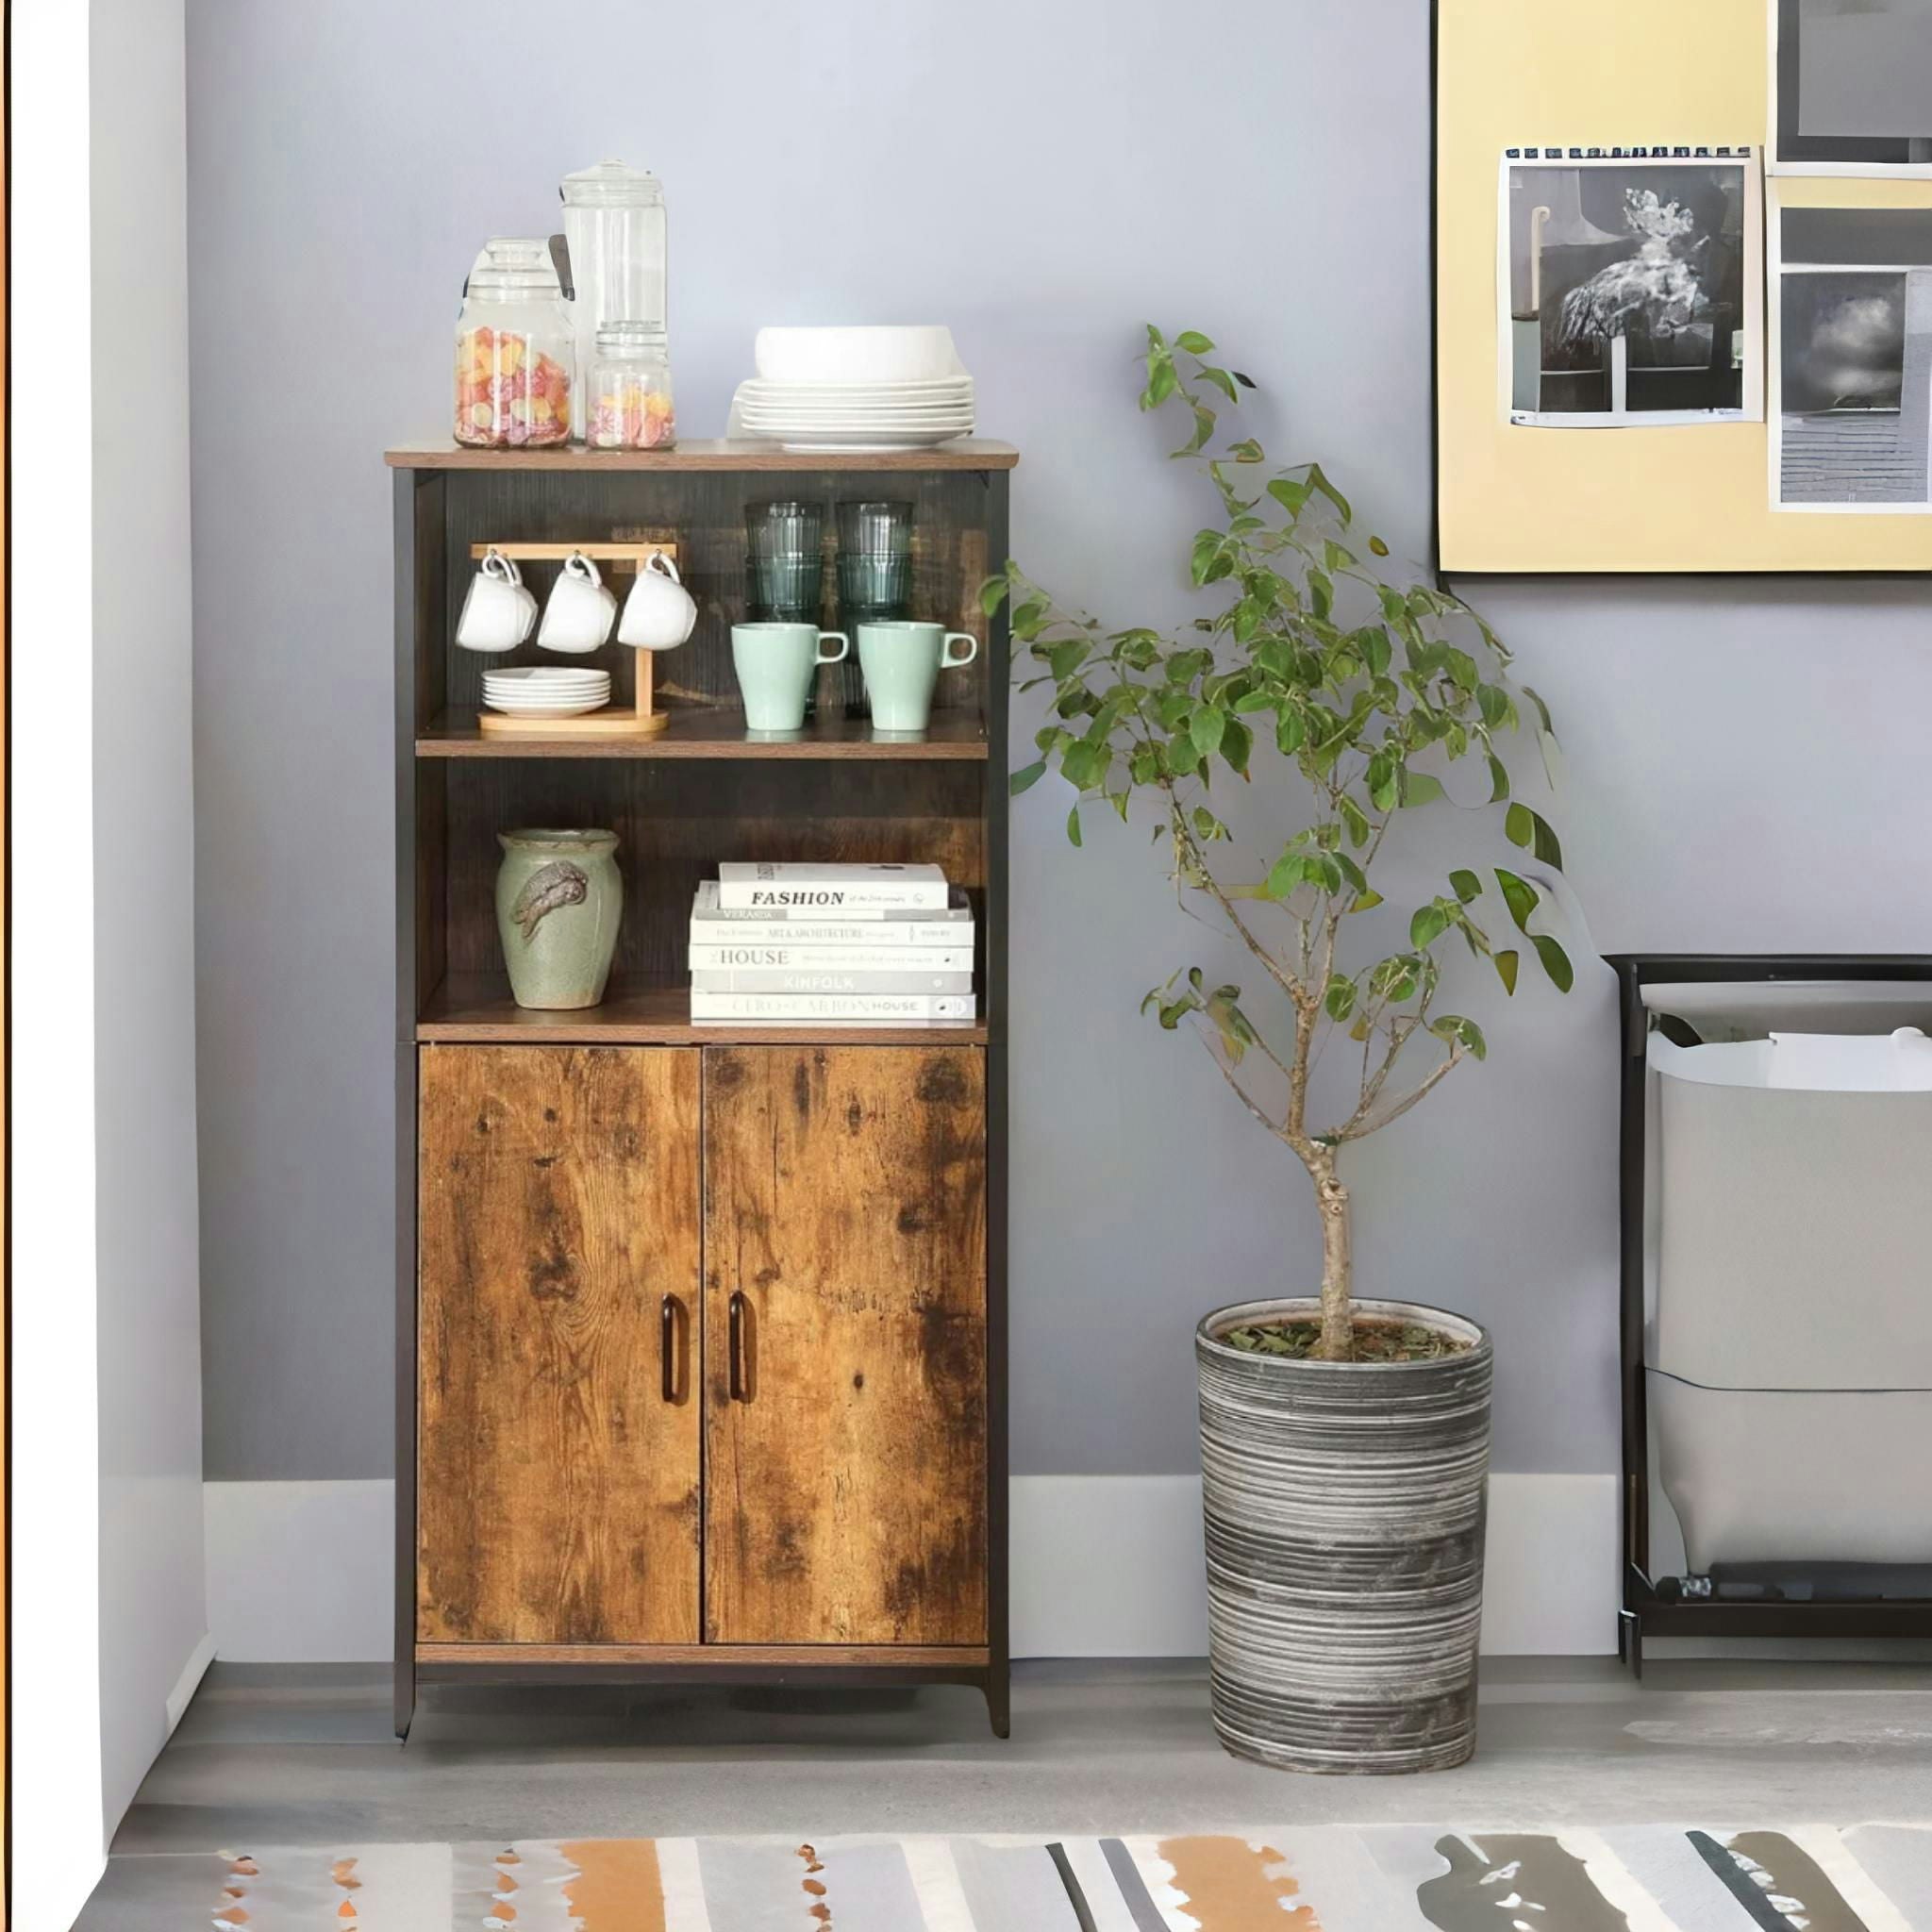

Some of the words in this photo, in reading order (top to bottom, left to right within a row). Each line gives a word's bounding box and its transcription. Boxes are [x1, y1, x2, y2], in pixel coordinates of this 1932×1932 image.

[752, 891, 845, 906] FASHION
[720, 949, 791, 965] HOUSE
[785, 974, 855, 990] KINFOLK
[872, 1002, 919, 1012] HOUSE
